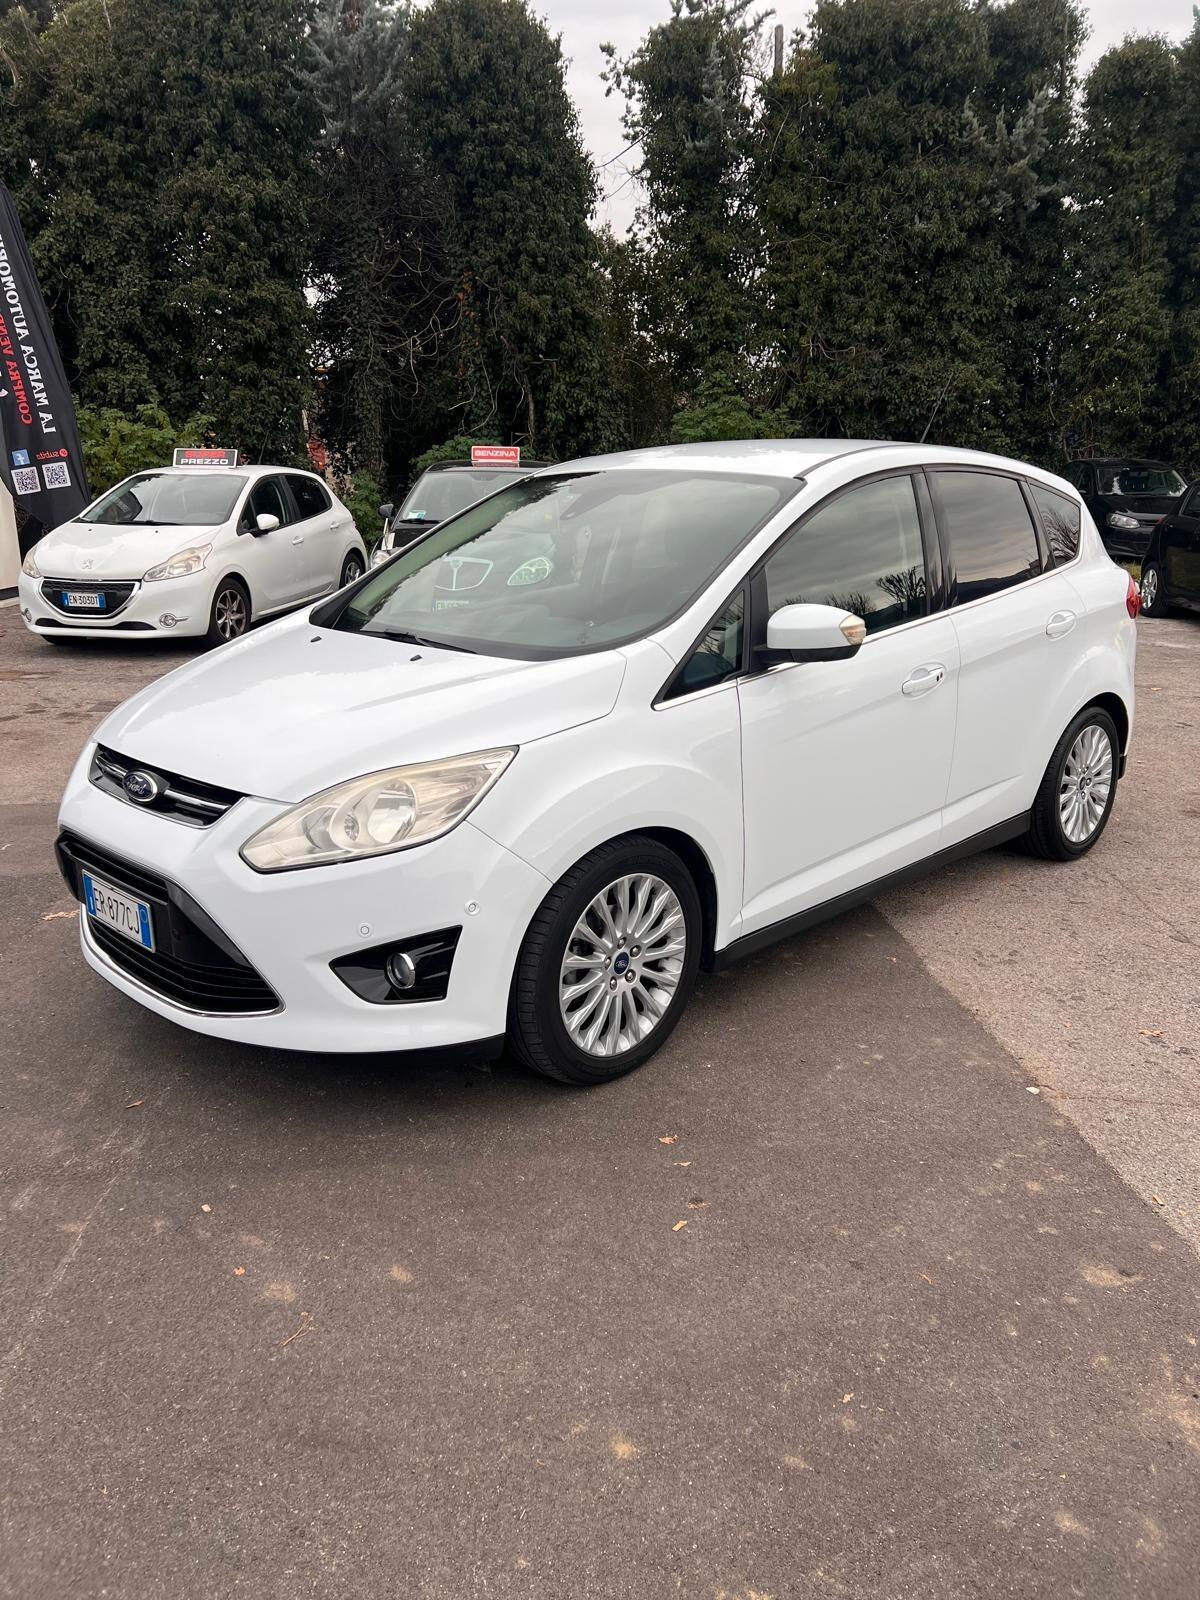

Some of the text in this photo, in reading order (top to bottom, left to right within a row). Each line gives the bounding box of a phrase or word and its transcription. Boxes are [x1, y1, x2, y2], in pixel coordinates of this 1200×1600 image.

[474, 449, 516, 458] BENZINA
[93, 888, 140, 934] ER 877CJ
